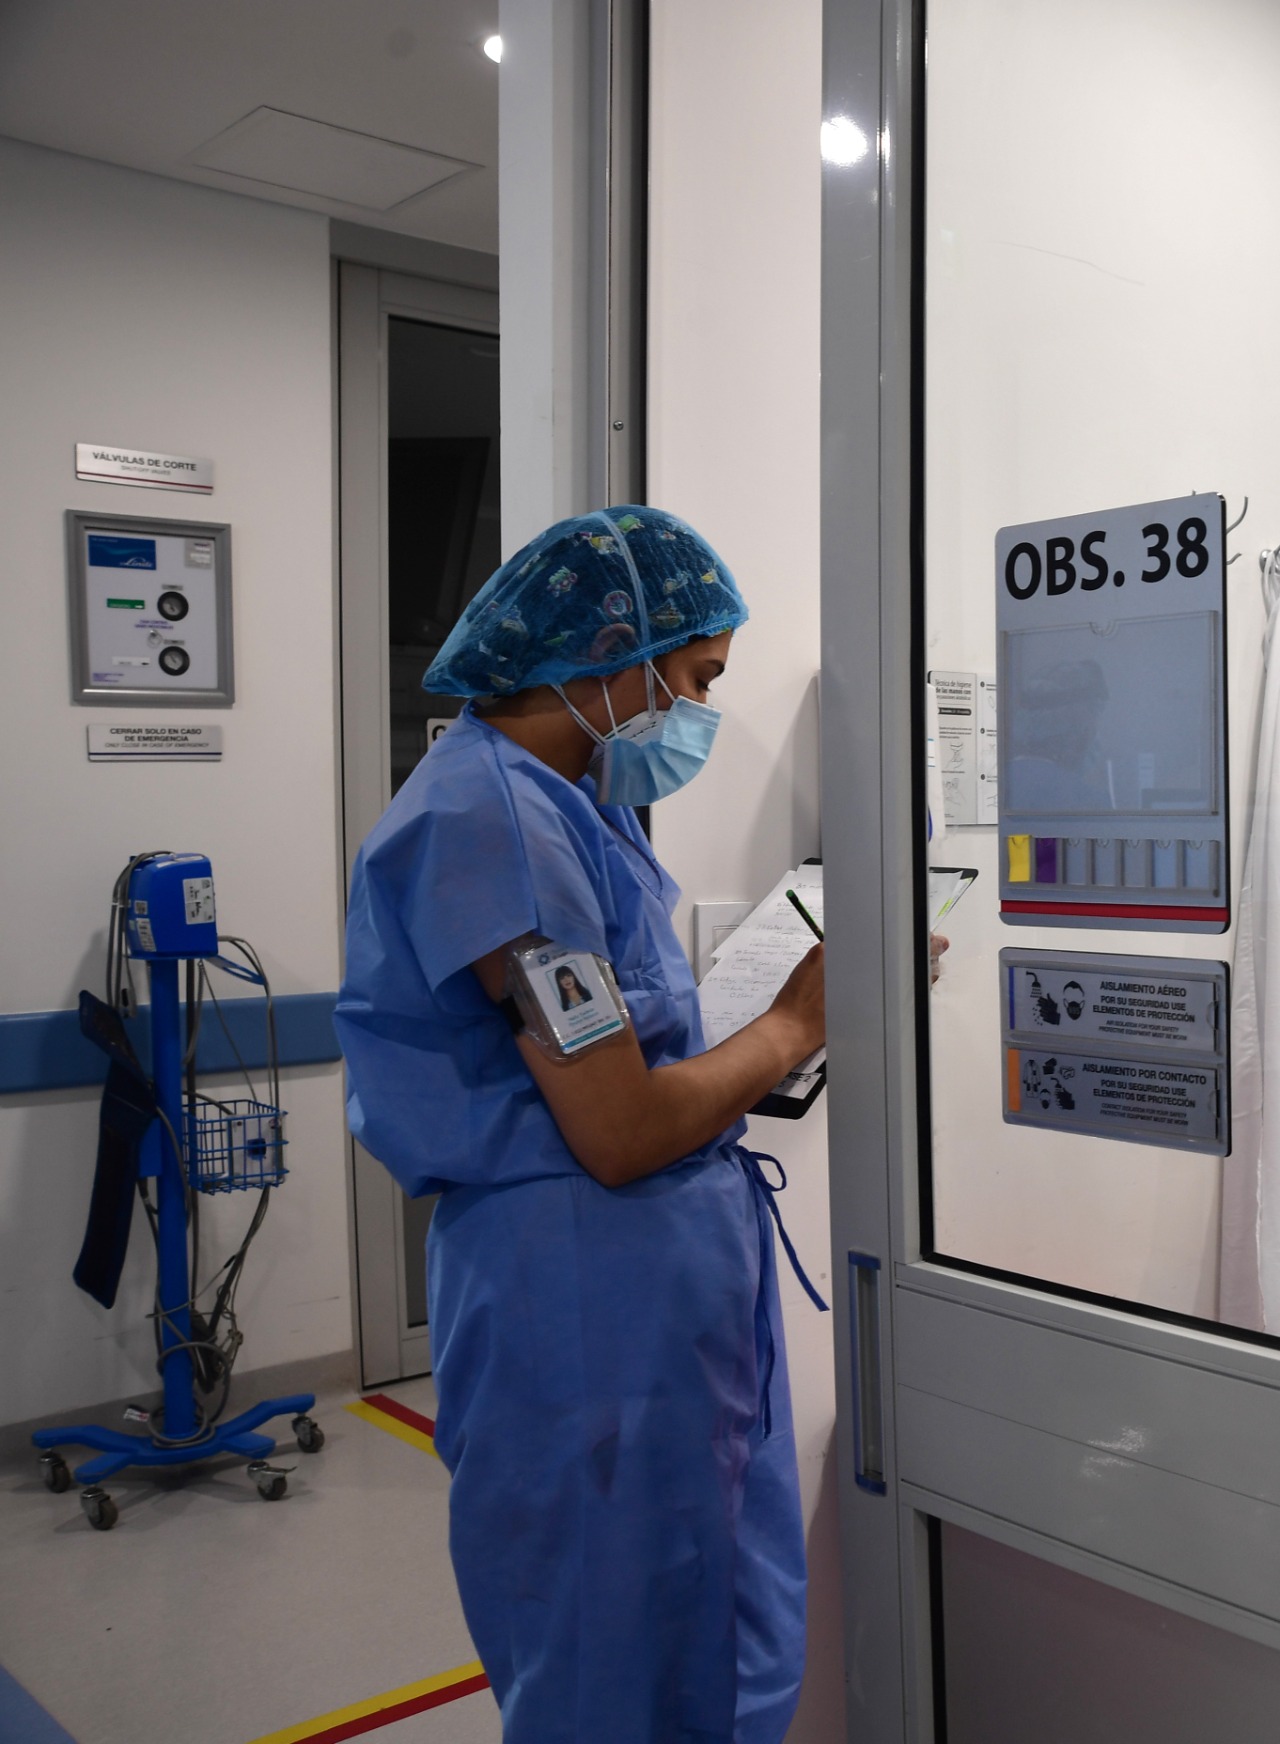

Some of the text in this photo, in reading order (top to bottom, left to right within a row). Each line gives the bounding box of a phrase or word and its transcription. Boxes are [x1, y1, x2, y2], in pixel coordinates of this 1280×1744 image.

[92, 451, 197, 471] VÁLVULAS DE CORTE
[1005, 517, 1209, 600] OBS. 38
[1100, 981, 1187, 997] AISLAMIENTO AÉREO
[1100, 995, 1186, 1011] POR SU SEGURIDAD USE
[1093, 1005, 1195, 1023] ELEMENTOS DE PROTECCIÓN
[1082, 1063, 1207, 1085] AISLAMIENTO POR CONTACTO
[1100, 1079, 1187, 1096] POR SU SEGURIDAD USE
[1093, 1088, 1196, 1108] ELEMENTOS DE PROTECCIÓN
